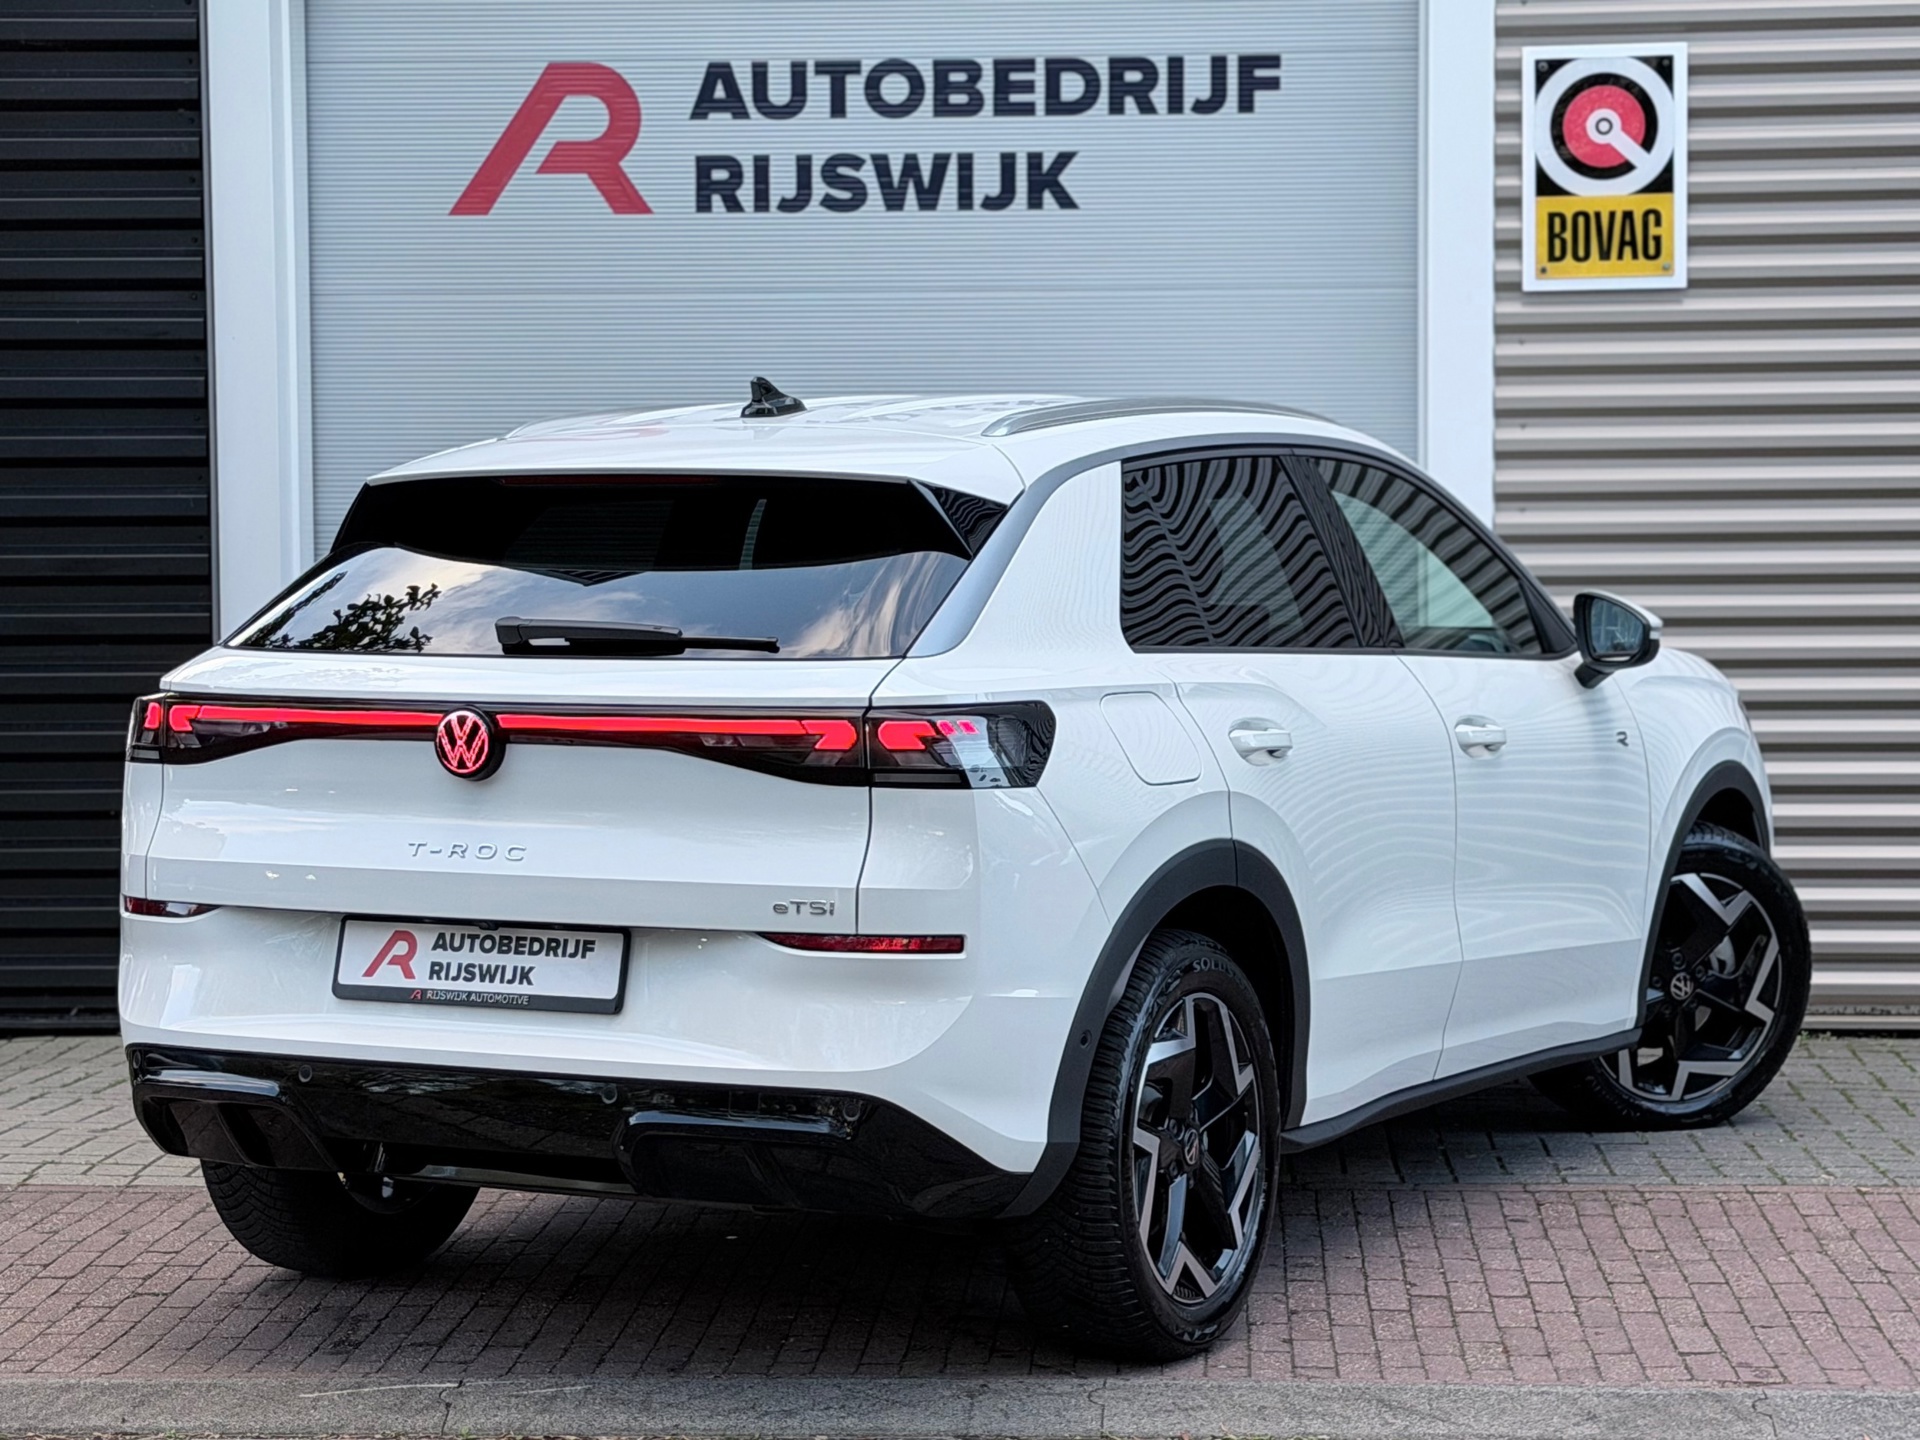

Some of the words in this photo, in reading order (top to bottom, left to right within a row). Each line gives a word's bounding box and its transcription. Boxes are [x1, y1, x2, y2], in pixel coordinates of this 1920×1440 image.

[689, 54, 1281, 120] AUTOBEDRIJF
[695, 151, 1080, 214] RIJSWIJK
[1547, 208, 1662, 263] BOVAG
[408, 841, 527, 862] T-ROC
[431, 932, 596, 960] AUTOBEDRIJF
[428, 961, 536, 986] RIJSWIJK
[426, 989, 468, 1002] RIJSWIJK
[469, 991, 530, 1005] AUTOMOTIVE
